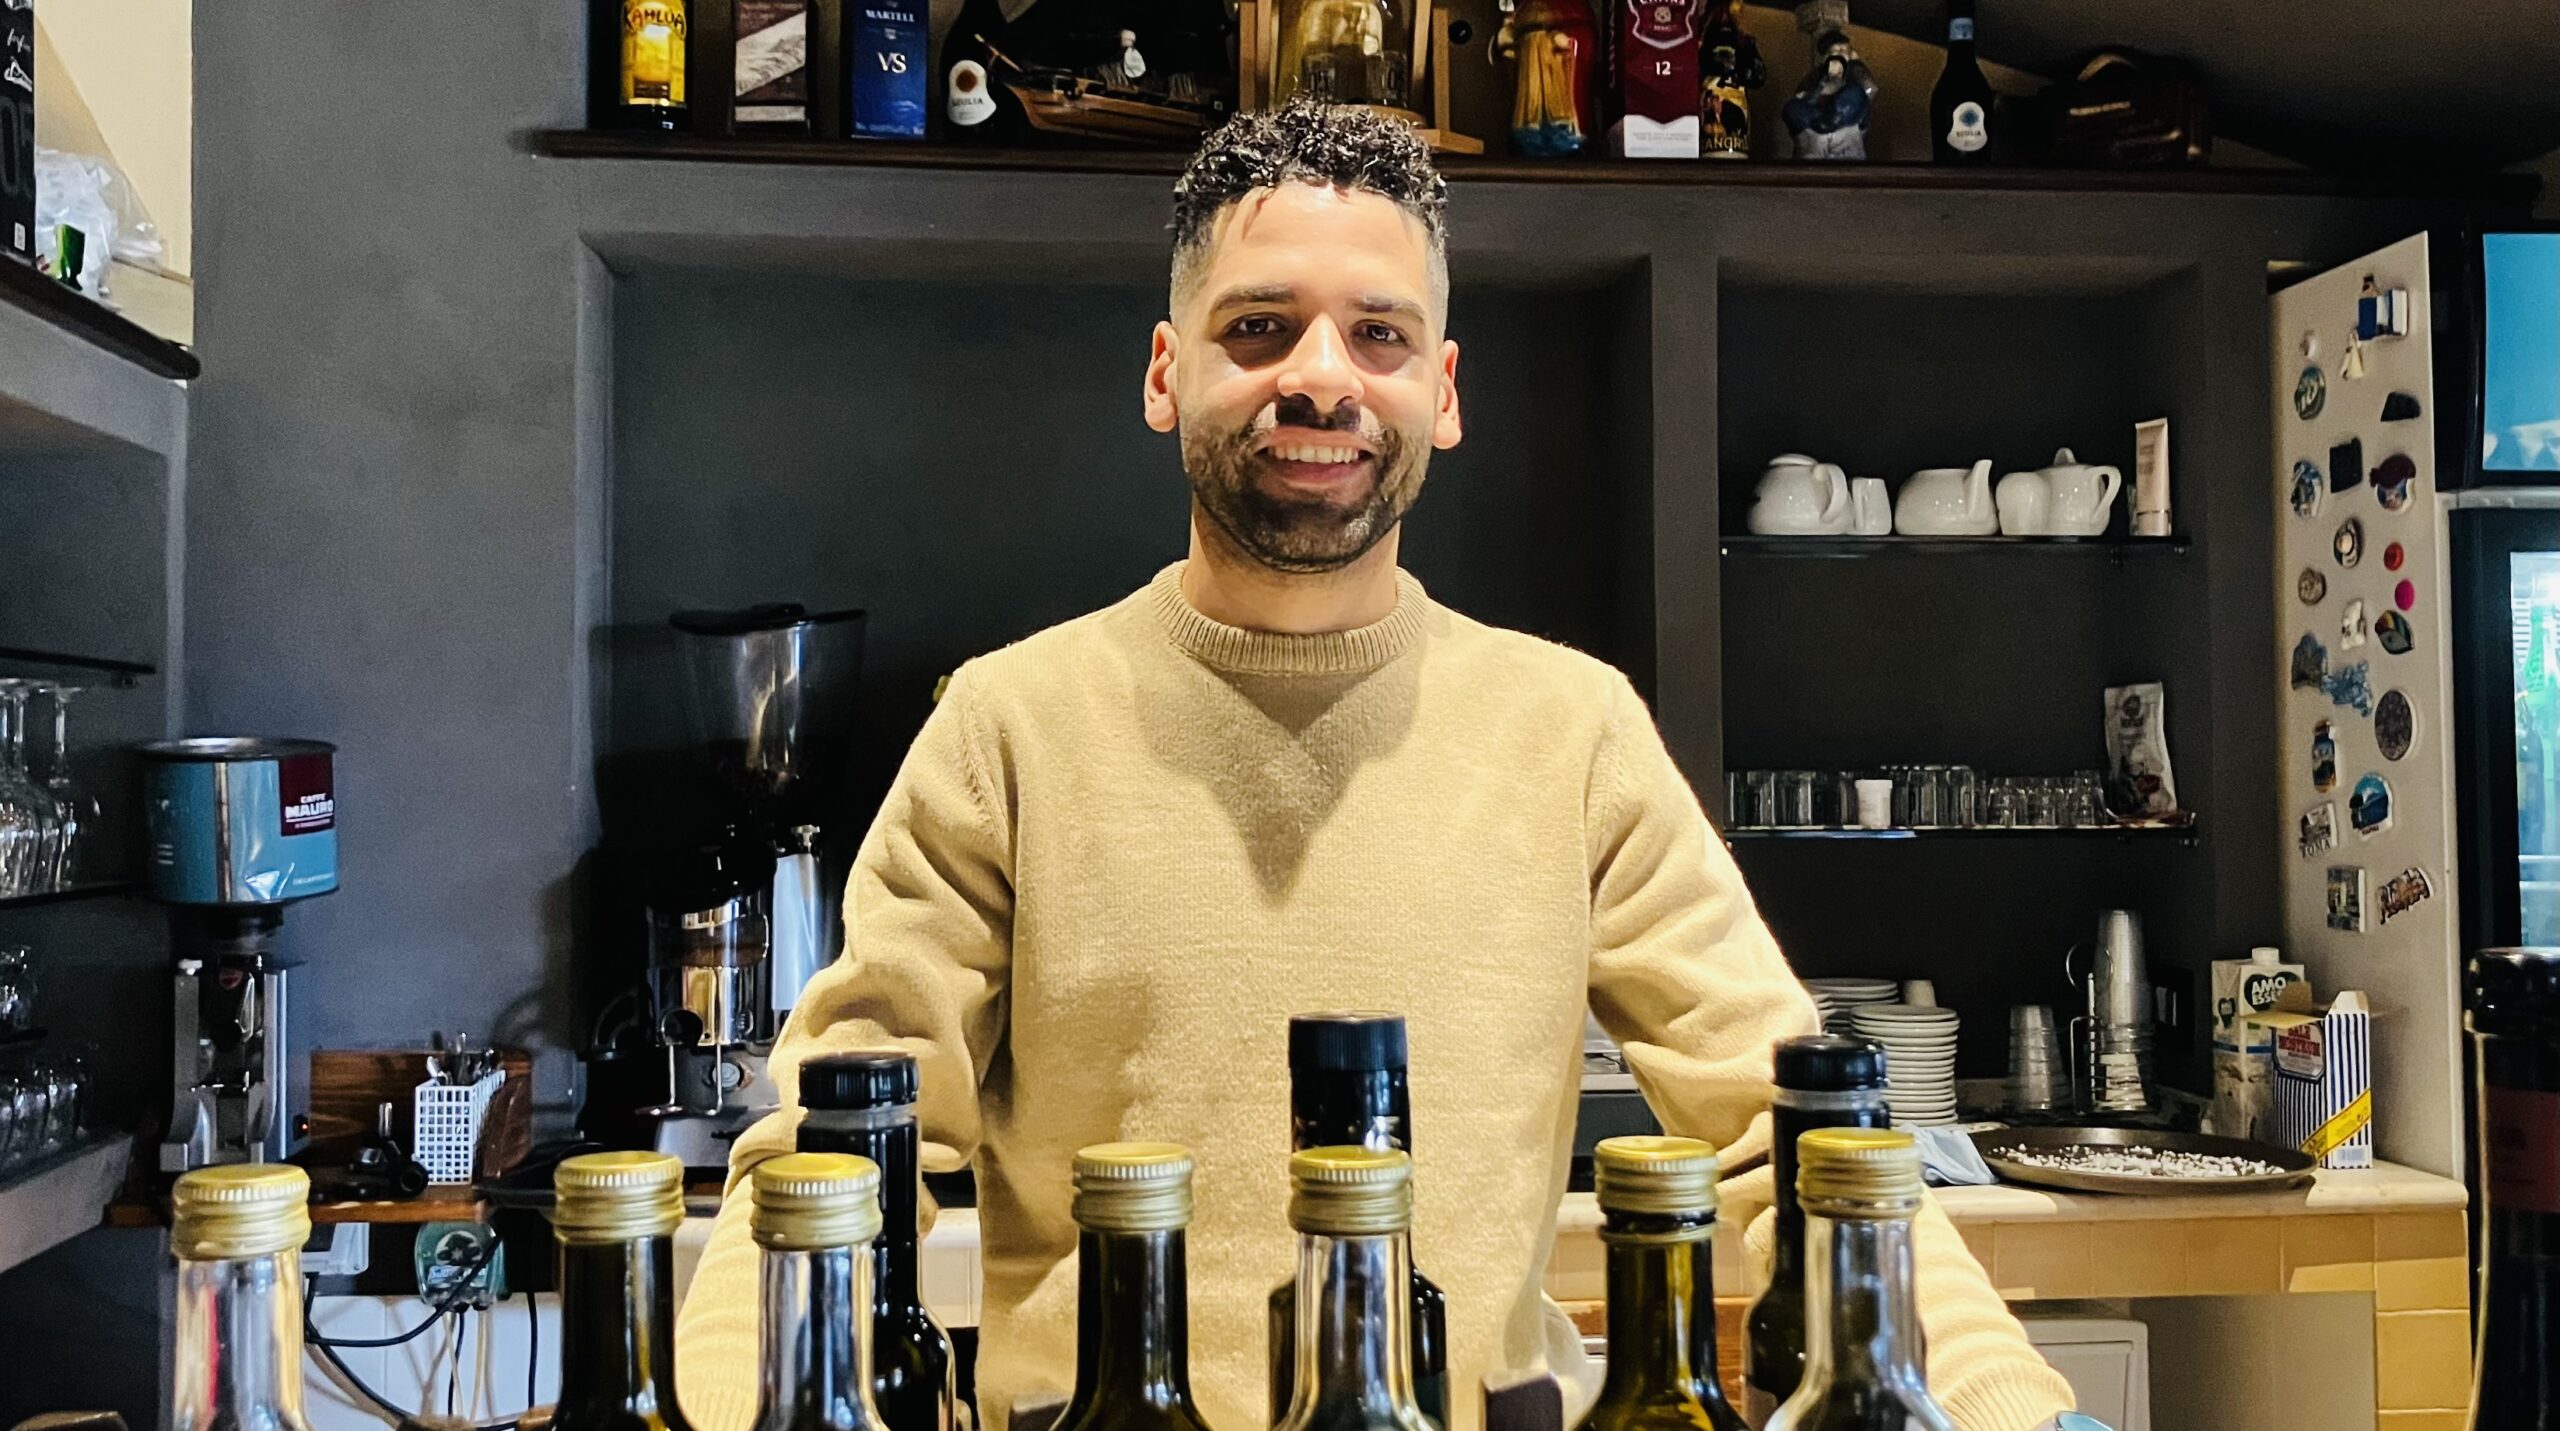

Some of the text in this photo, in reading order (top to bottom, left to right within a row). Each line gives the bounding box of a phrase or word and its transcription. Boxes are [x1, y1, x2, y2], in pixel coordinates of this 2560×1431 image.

[865, 9, 915, 23] MARTELL
[877, 52, 907, 74] VS
[1655, 61, 1672, 76] 12
[285, 799, 334, 819] MAURO
[2252, 976, 2287, 994] AMO
